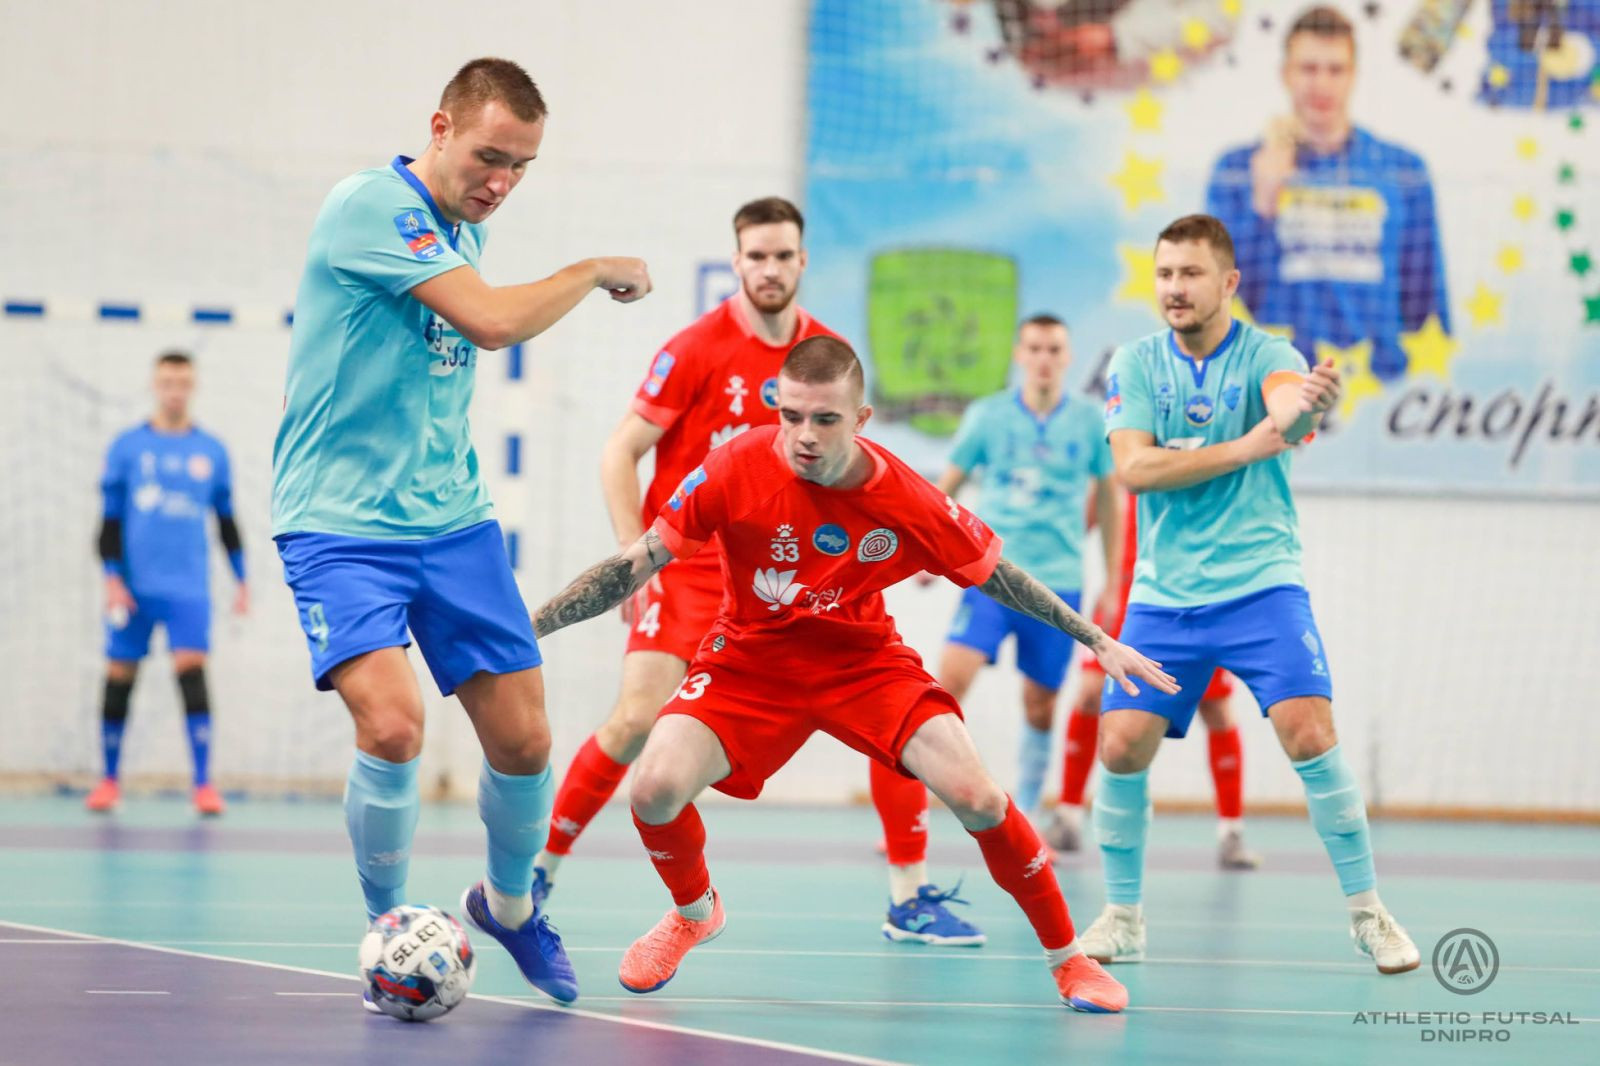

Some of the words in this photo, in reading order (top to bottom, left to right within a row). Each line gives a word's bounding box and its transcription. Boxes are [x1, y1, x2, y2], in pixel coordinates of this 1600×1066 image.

[770, 543, 800, 562] 33
[637, 601, 661, 638] 4
[392, 920, 444, 967] SELECT
